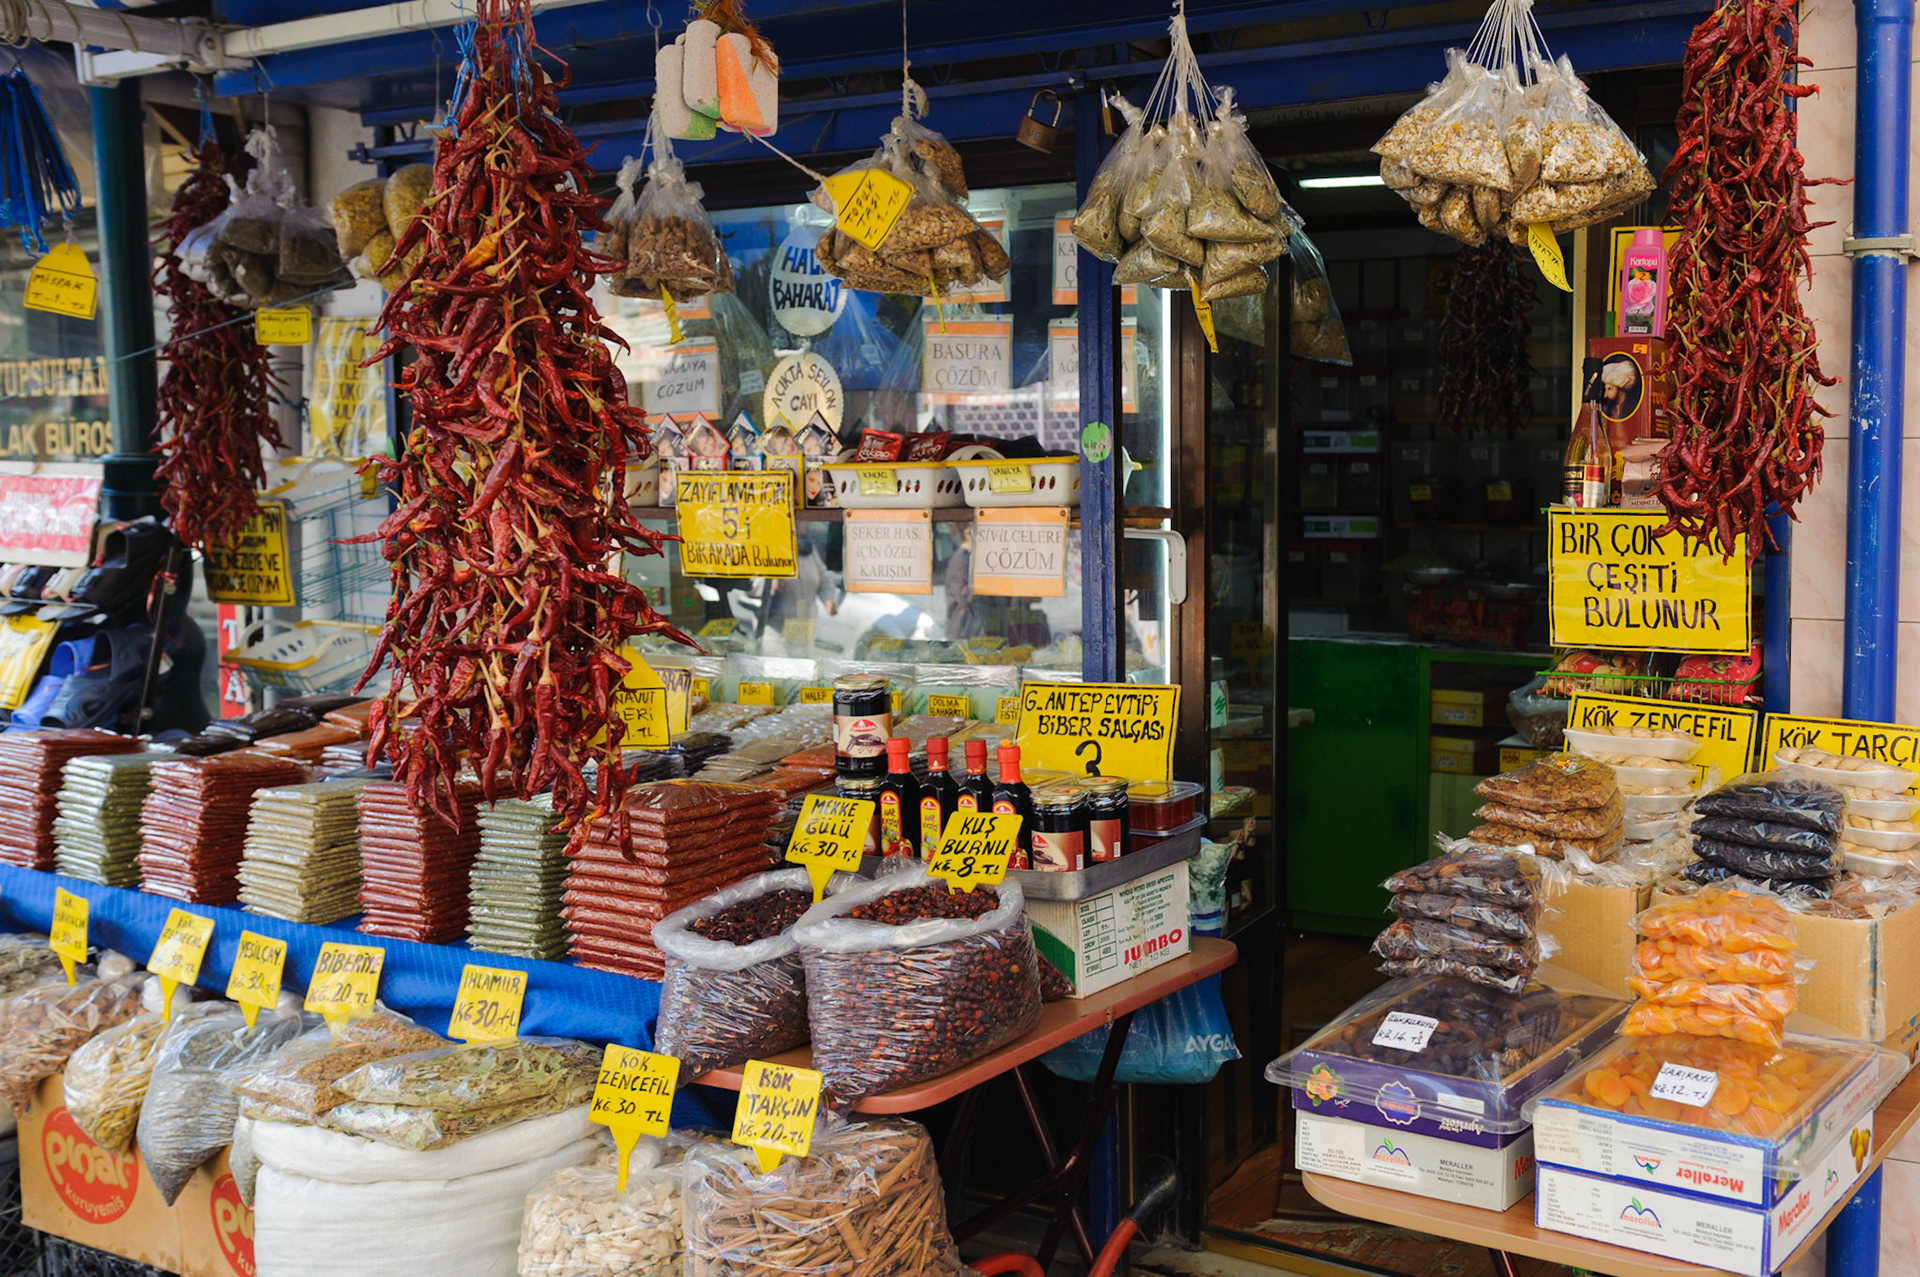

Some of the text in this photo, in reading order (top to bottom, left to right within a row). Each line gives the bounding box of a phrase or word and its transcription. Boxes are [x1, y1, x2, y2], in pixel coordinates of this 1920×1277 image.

[933, 343, 1002, 361] BASURA
[935, 365, 999, 390] ÇÖZÜM
[679, 482, 756, 504] ZAYIFLAMA
[851, 526, 922, 541] ŞEKER HAS.
[1561, 522, 1603, 556] BİR
[1611, 523, 1666, 557] ÇOK
[857, 544, 916, 561] İÇİN ÖZEL
[985, 548, 1056, 575] ÇÖZÜM
[860, 564, 913, 581] KARIŞIM
[1587, 561, 1678, 595] ÇEŞİTİ
[1584, 596, 1721, 631] BULUNUR
[933, 698, 960, 708] DOLMA
[1584, 705, 1620, 727] KÖK
[1038, 714, 1165, 744] BİBER SALÇASI
[1780, 726, 1822, 749] KÖK
[811, 798, 859, 818] MEKKE
[960, 816, 999, 839] KUŞ
[941, 839, 1010, 856] BURNU
[1124, 928, 1183, 965] JUMBO
[1128, 959, 1143, 970] NET
[1160, 947, 1170, 959] KG
[599, 1070, 670, 1097] ZENCEFİL
[759, 1066, 794, 1093] KÖK
[746, 1092, 815, 1119] TARÇIN
[1440, 1117, 1485, 1136] Apricots
[1439, 1159, 1474, 1171] MERALLER
[1676, 1167, 1745, 1194] Meraller
[64, 1181, 125, 1220] kuruyemiş
[1620, 1213, 1661, 1229] meraller
[1777, 1190, 1811, 1238] Meraller
[1695, 1221, 1734, 1234] MERALLER
